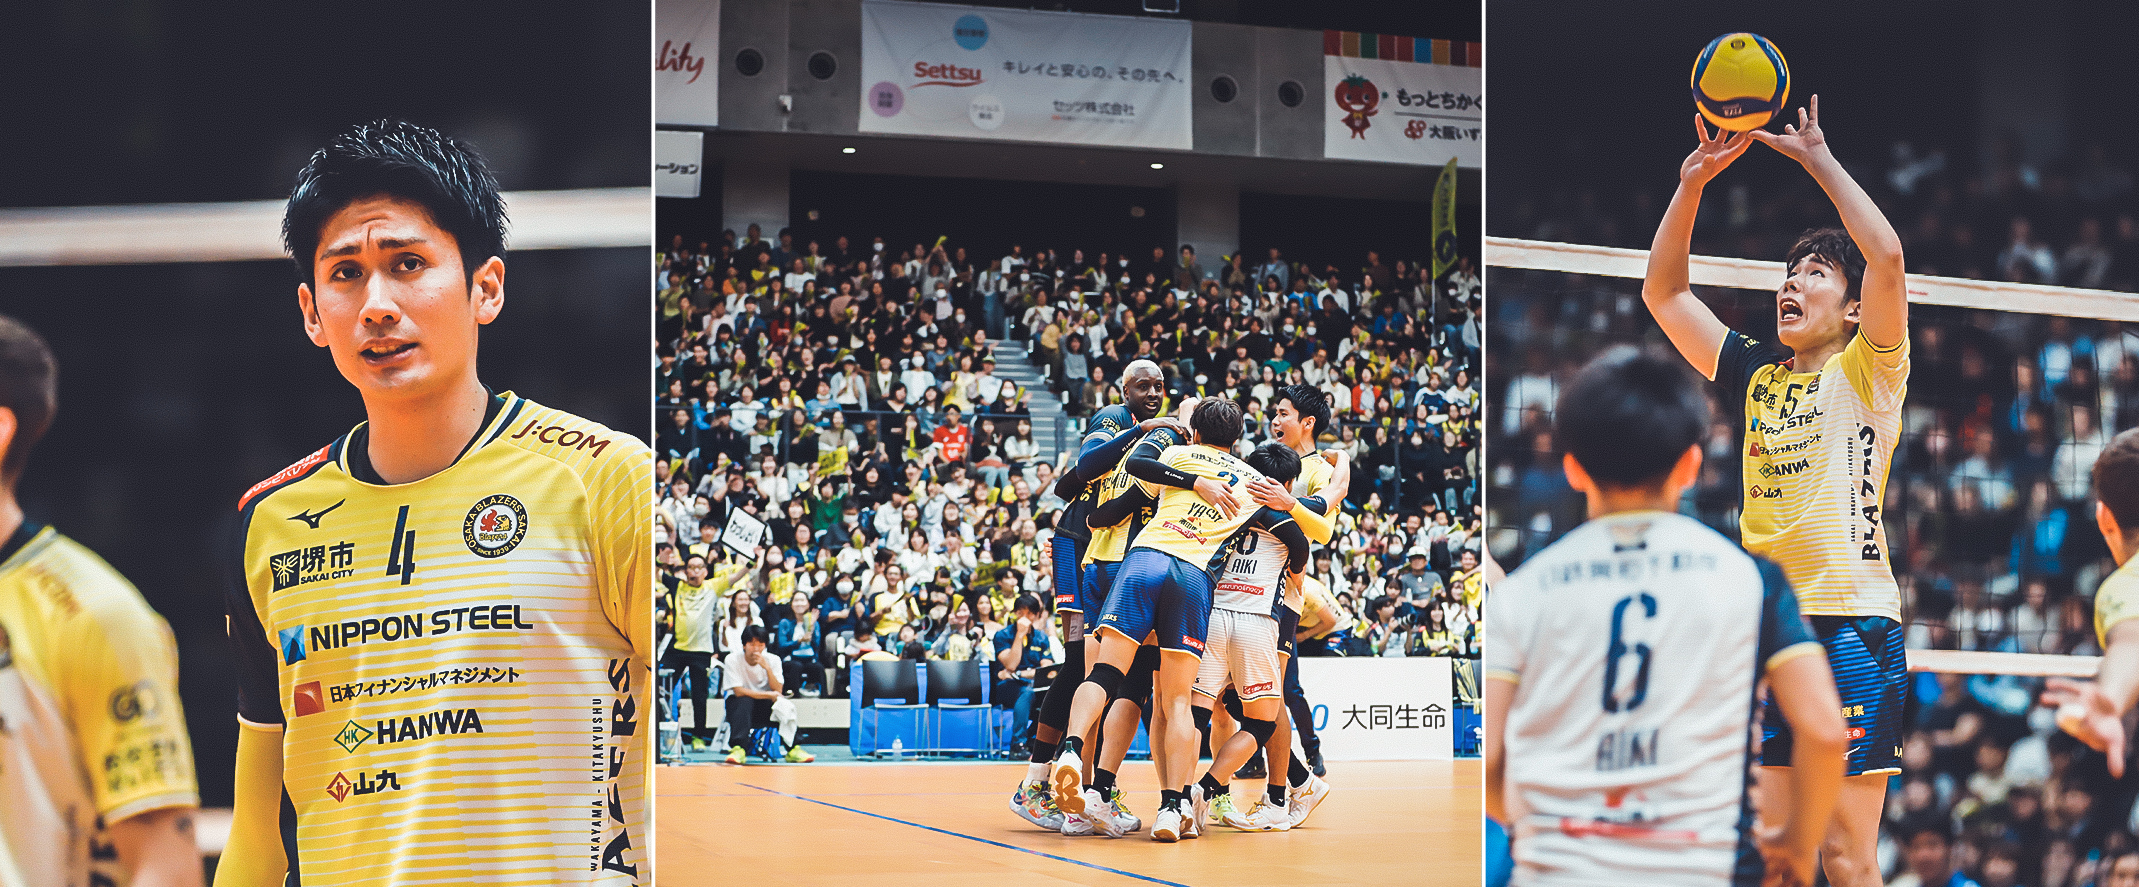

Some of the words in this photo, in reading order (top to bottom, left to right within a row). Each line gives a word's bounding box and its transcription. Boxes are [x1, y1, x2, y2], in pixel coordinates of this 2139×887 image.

[655, 40, 704, 84] lity
[914, 61, 982, 81] Settsu
[655, 163, 699, 175] ーション
[511, 419, 611, 459] J:COM
[1774, 458, 1810, 476] ANWA
[465, 513, 478, 548] OSAKA
[475, 495, 523, 513] BLAZERS
[509, 514, 527, 547] SAKAI
[301, 540, 355, 573] 堺市
[386, 505, 416, 585] 4
[300, 572, 330, 585] SAKAI
[331, 568, 355, 580] CITY
[1231, 558, 1258, 575] AIKI
[310, 612, 424, 652] NIPPON
[431, 605, 534, 637] STEEL
[1603, 592, 1658, 714] 6
[329, 666, 520, 703] 日本フィナンシャルマネジメント
[377, 708, 484, 745] HANWA
[1342, 703, 1447, 730] 大同生命
[592, 698, 604, 783] KITAKYUSHU
[352, 769, 401, 796] 山九
[590, 800, 603, 872] WAKAYAMA
